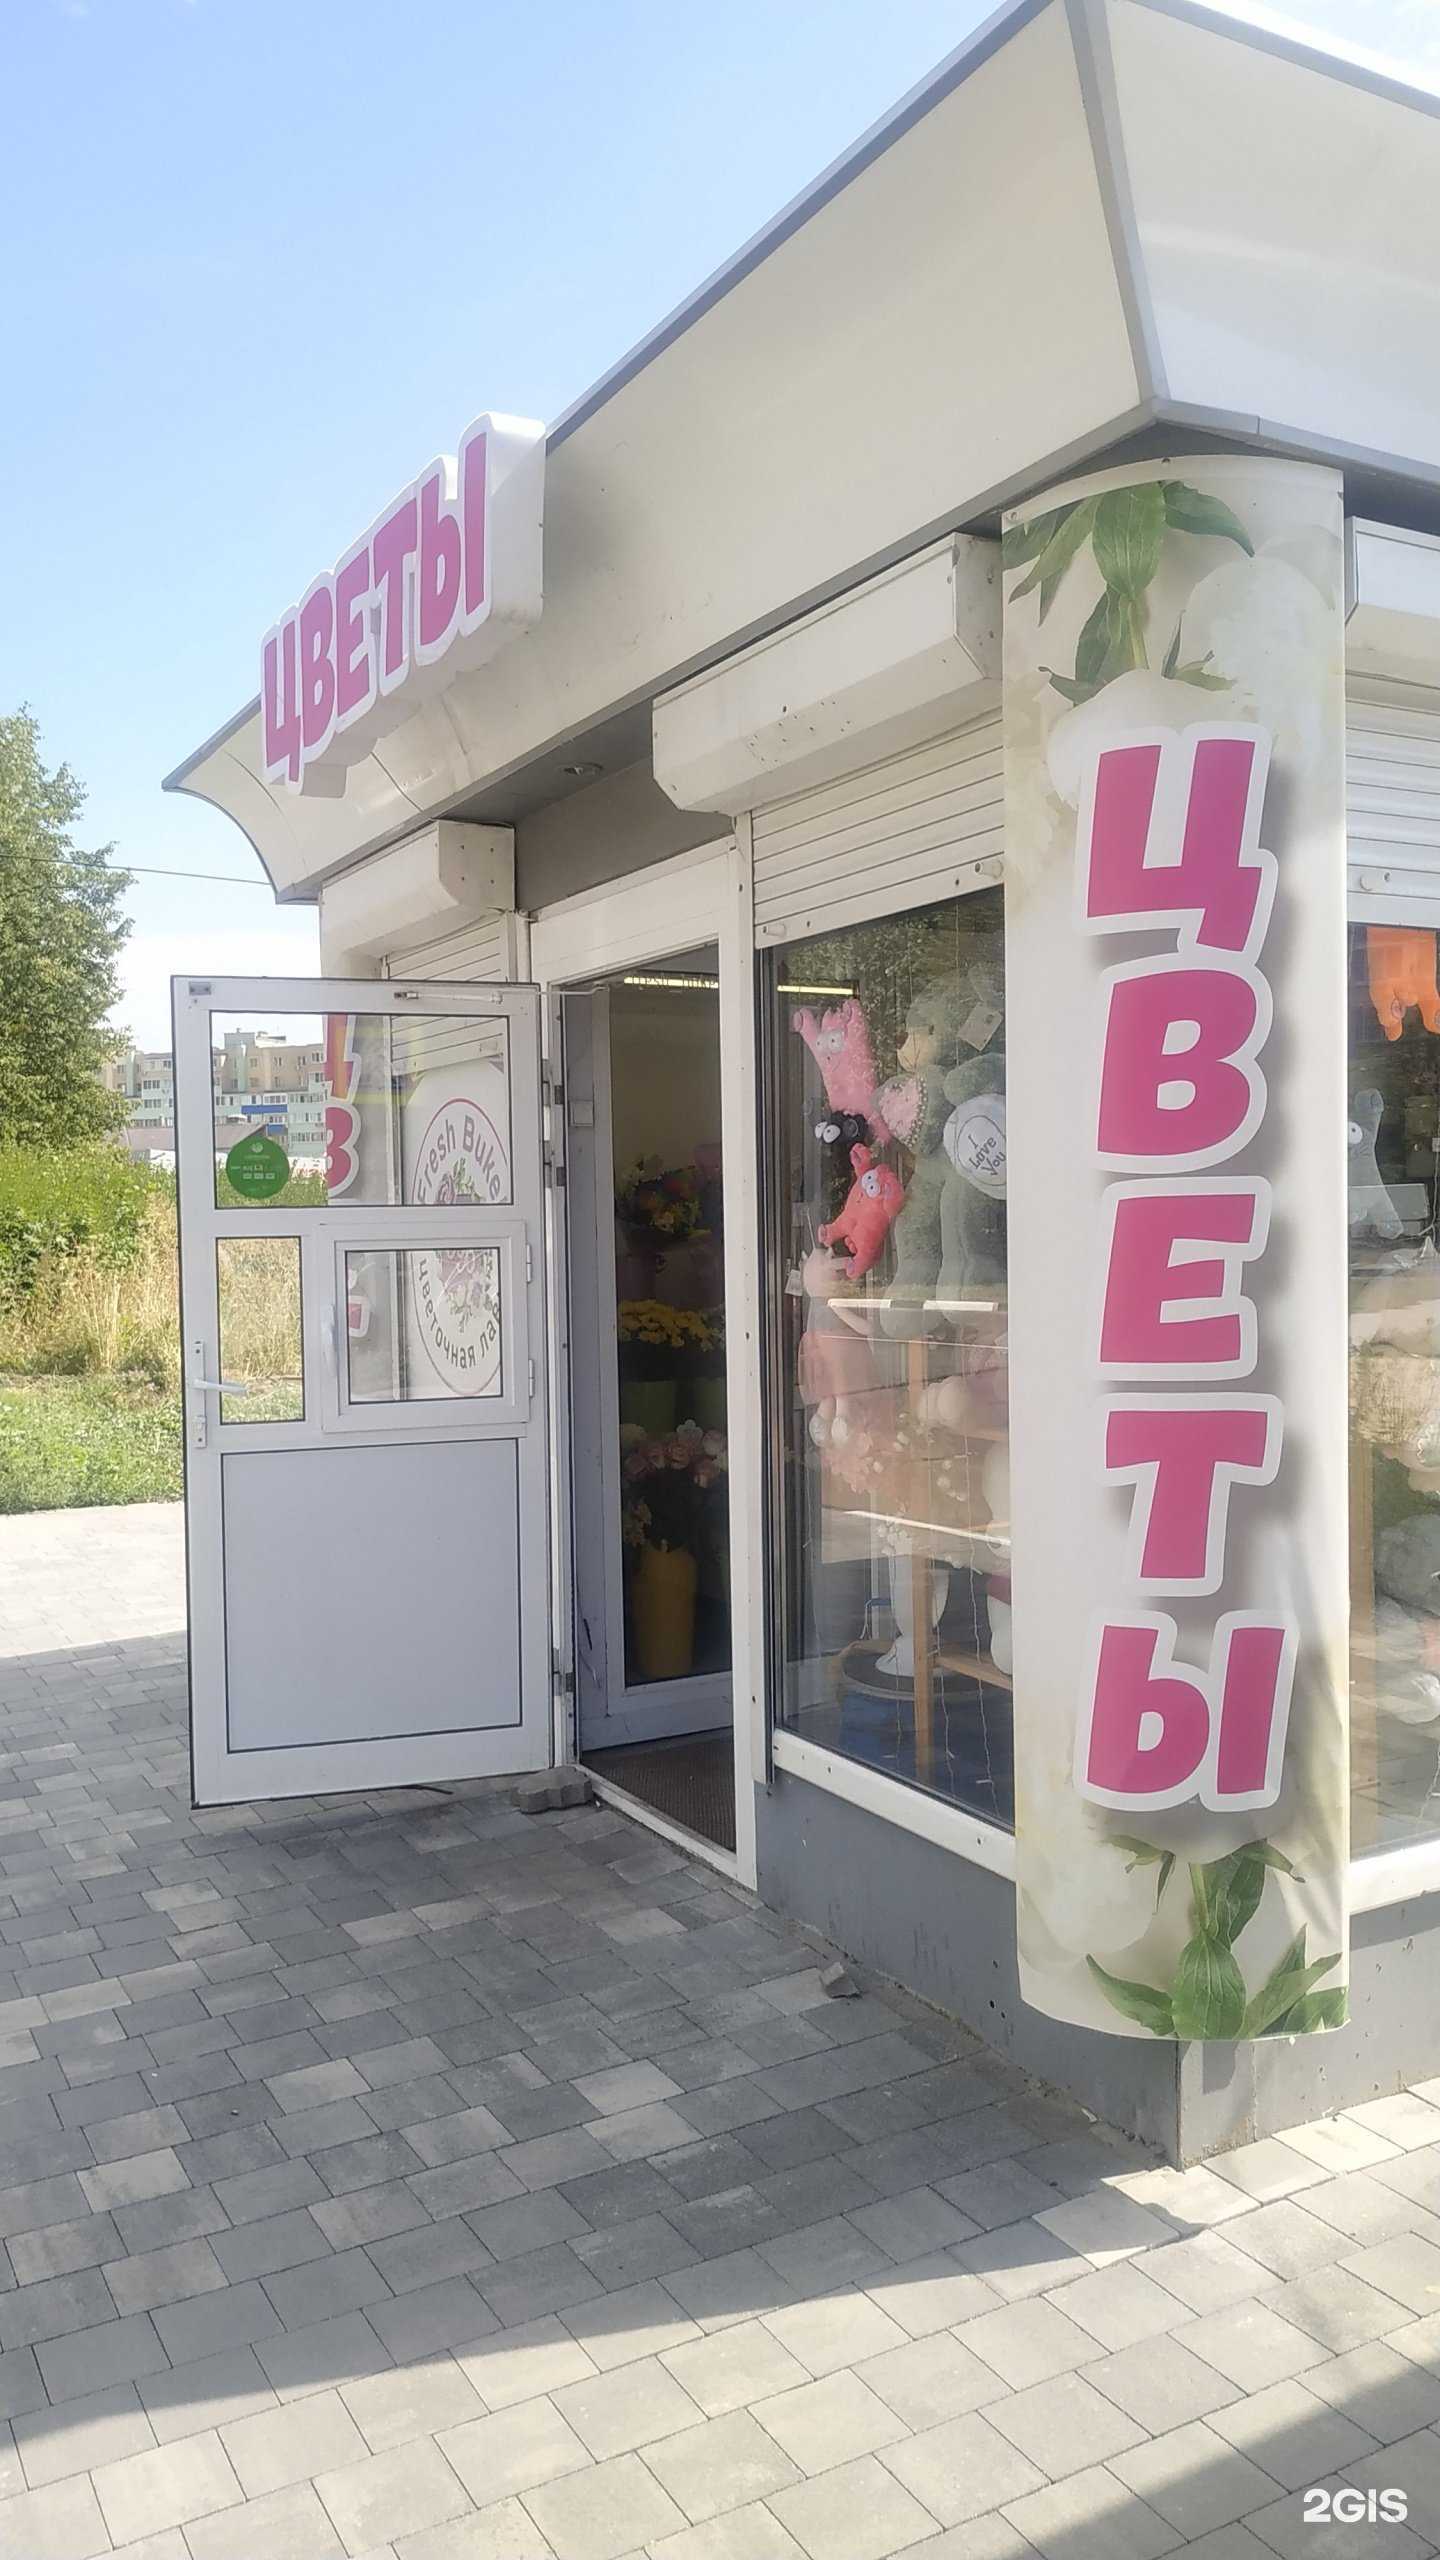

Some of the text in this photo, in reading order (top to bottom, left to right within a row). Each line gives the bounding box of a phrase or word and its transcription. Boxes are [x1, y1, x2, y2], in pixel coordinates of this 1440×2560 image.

[262, 430, 488, 785] ЦВЕТЫ
[417, 1119, 457, 1203] Fresh
[967, 1133, 979, 1150] I
[980, 1150, 1007, 1176] You
[1083, 736, 1287, 1798] ЦВЕТЫ
